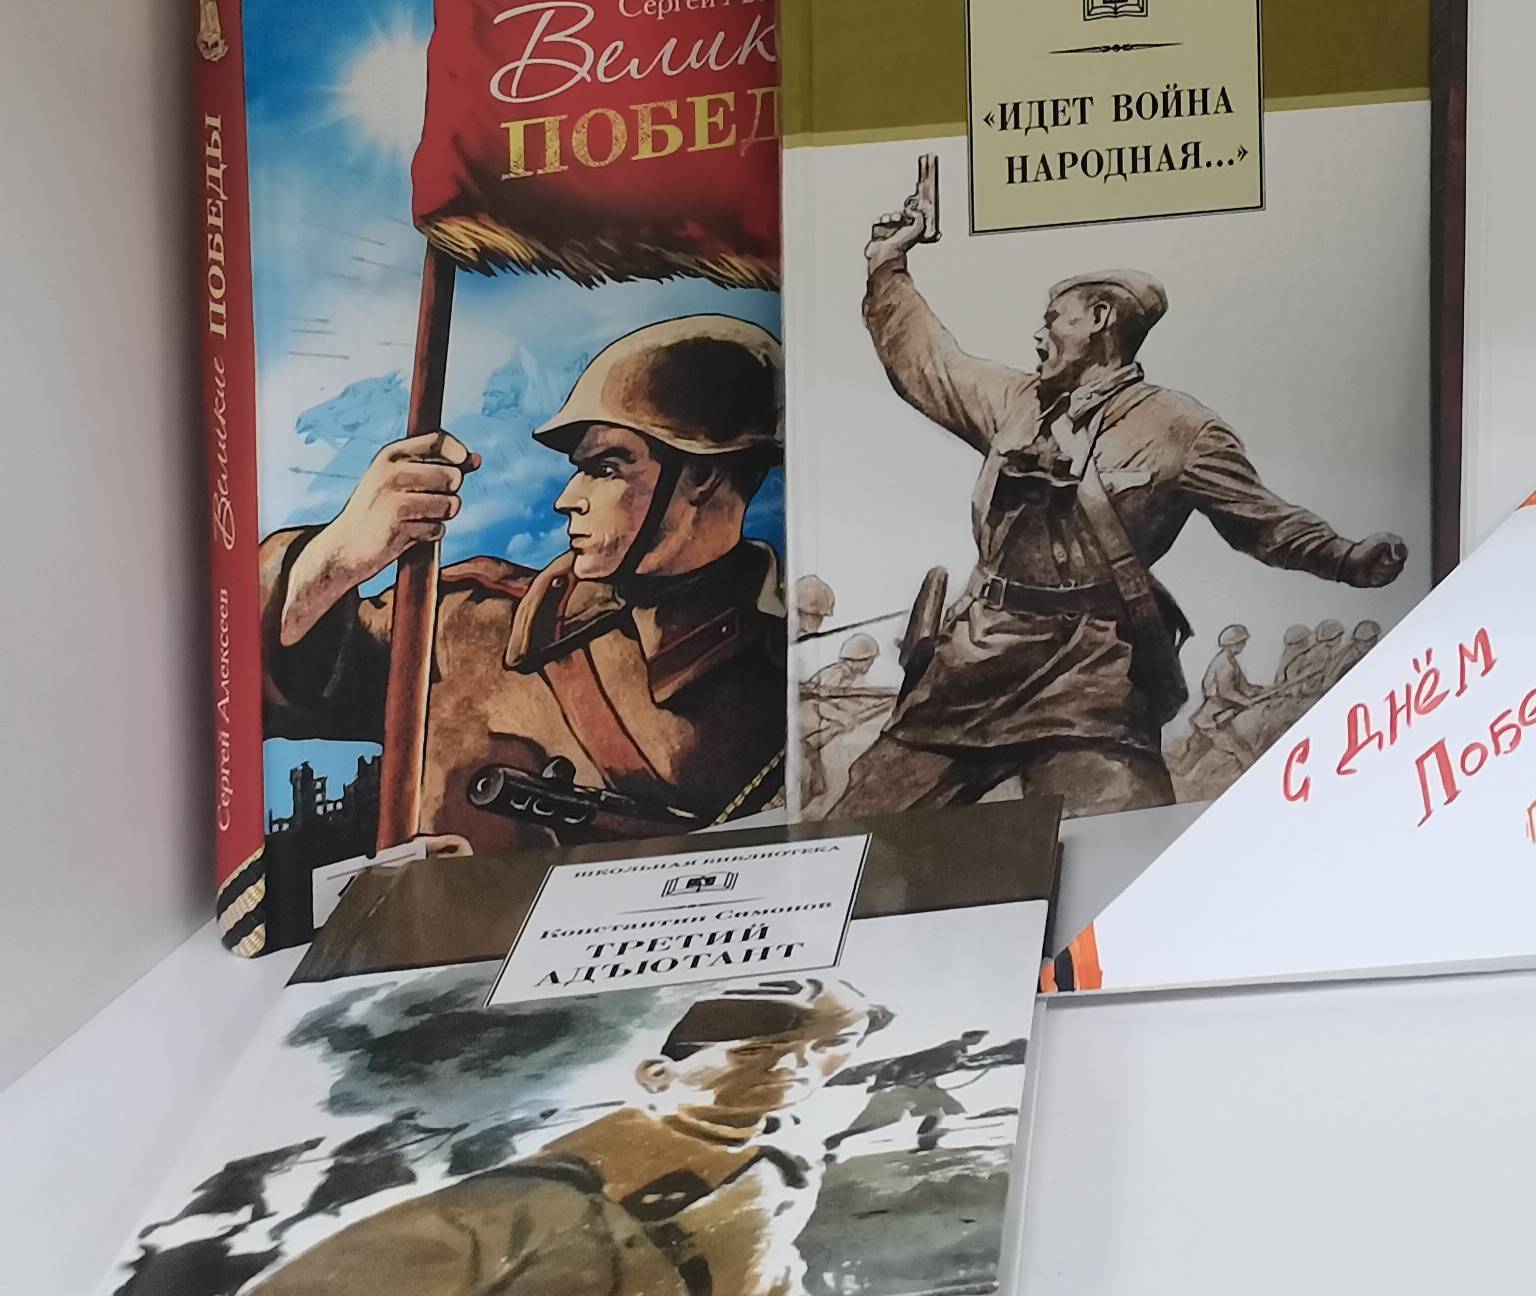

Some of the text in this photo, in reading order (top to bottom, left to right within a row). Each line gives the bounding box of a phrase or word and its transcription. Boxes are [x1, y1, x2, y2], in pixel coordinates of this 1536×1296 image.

[982, 82, 1235, 136] «ИДЕТ ВОЙНА
[204, 112, 229, 339] ПОБЕДЫ
[216, 588, 231, 723] Алексеев
[216, 730, 231, 833] Сергей
[574, 845, 841, 879] ШКОЛЬНАЯ БИБЛИОТЕКА
[539, 901, 833, 940] Константин Симонов
[586, 923, 771, 960] ТРЕТИЙ
[534, 943, 805, 988] АДЪЮТАНТ
